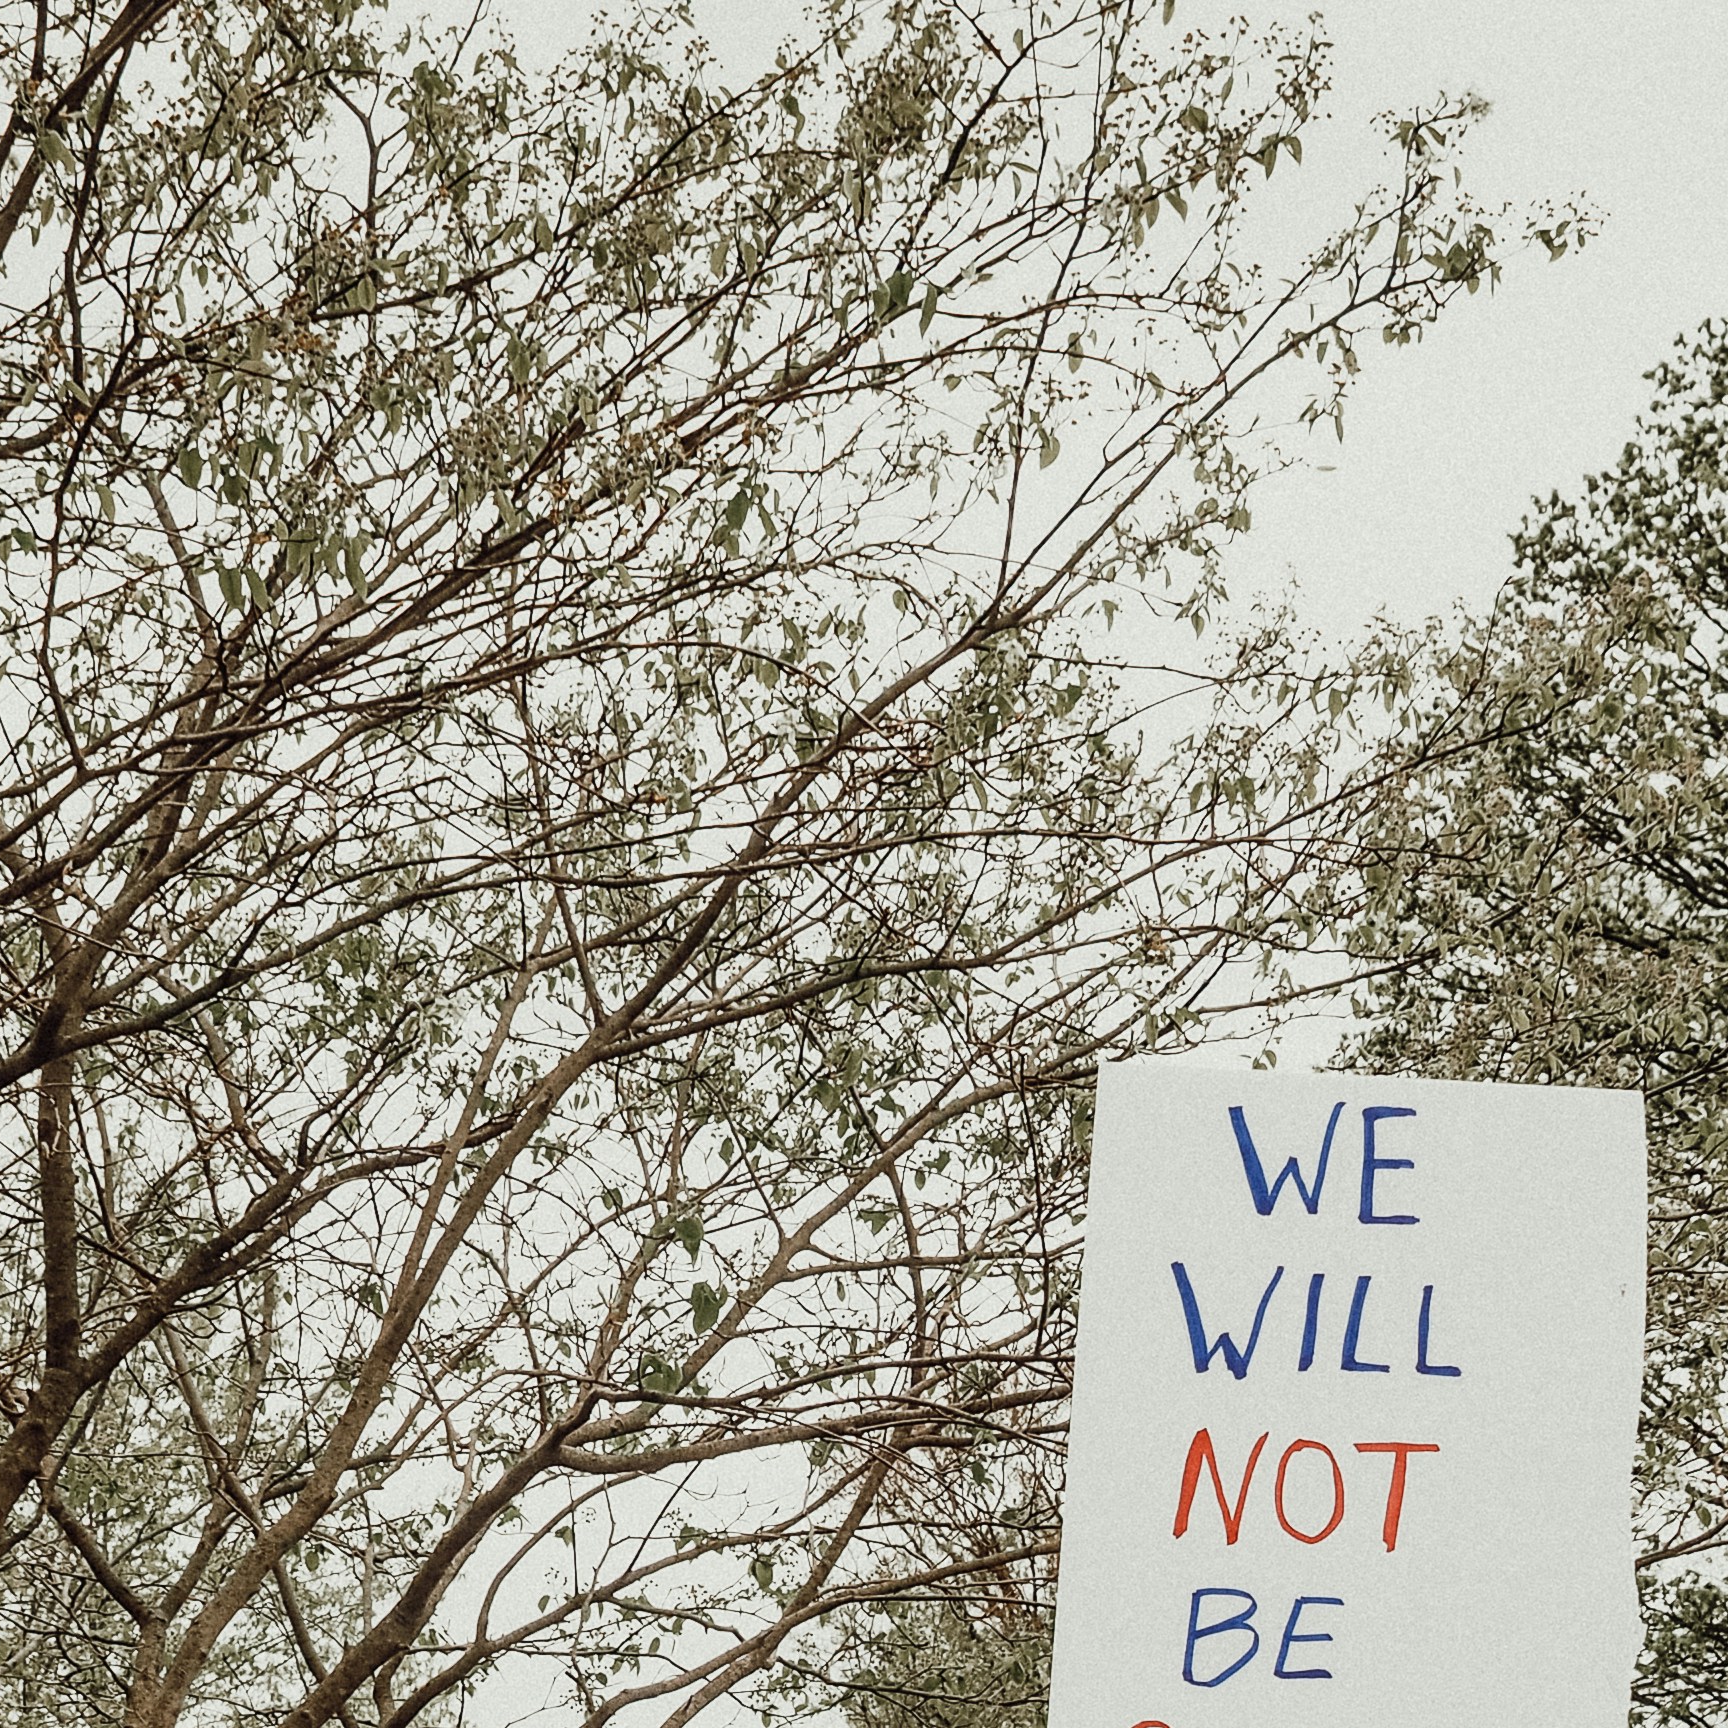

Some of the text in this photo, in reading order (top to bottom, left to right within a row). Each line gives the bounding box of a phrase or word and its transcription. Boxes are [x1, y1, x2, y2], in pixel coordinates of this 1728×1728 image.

[1228, 1101, 1420, 1225] WE
[1171, 1261, 1462, 1380] WILL
[1172, 1428, 1440, 1553] NOT
[1183, 1588, 1345, 1688] BE
